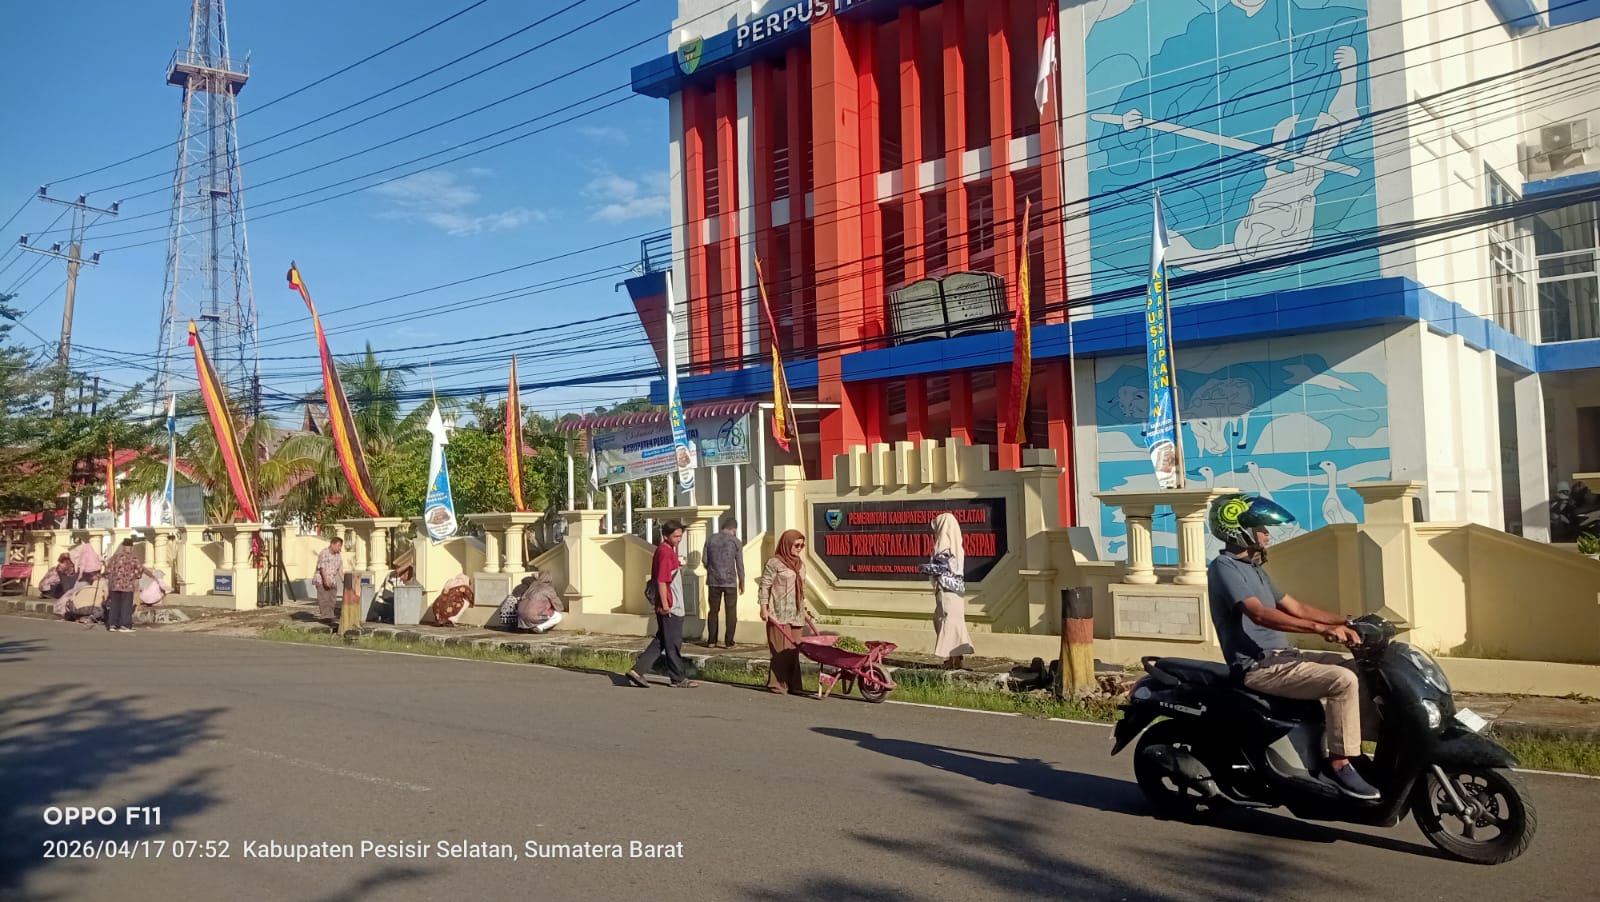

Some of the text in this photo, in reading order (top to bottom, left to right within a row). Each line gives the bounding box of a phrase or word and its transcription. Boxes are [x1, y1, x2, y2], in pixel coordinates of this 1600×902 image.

[737, 0, 852, 48] PERPUS
[848, 511, 888, 525] PEMERINTAH
[888, 510, 927, 524] KABUPATEN
[825, 533, 997, 556] DINAS PERPUSTAKAAN DA RSIPAN
